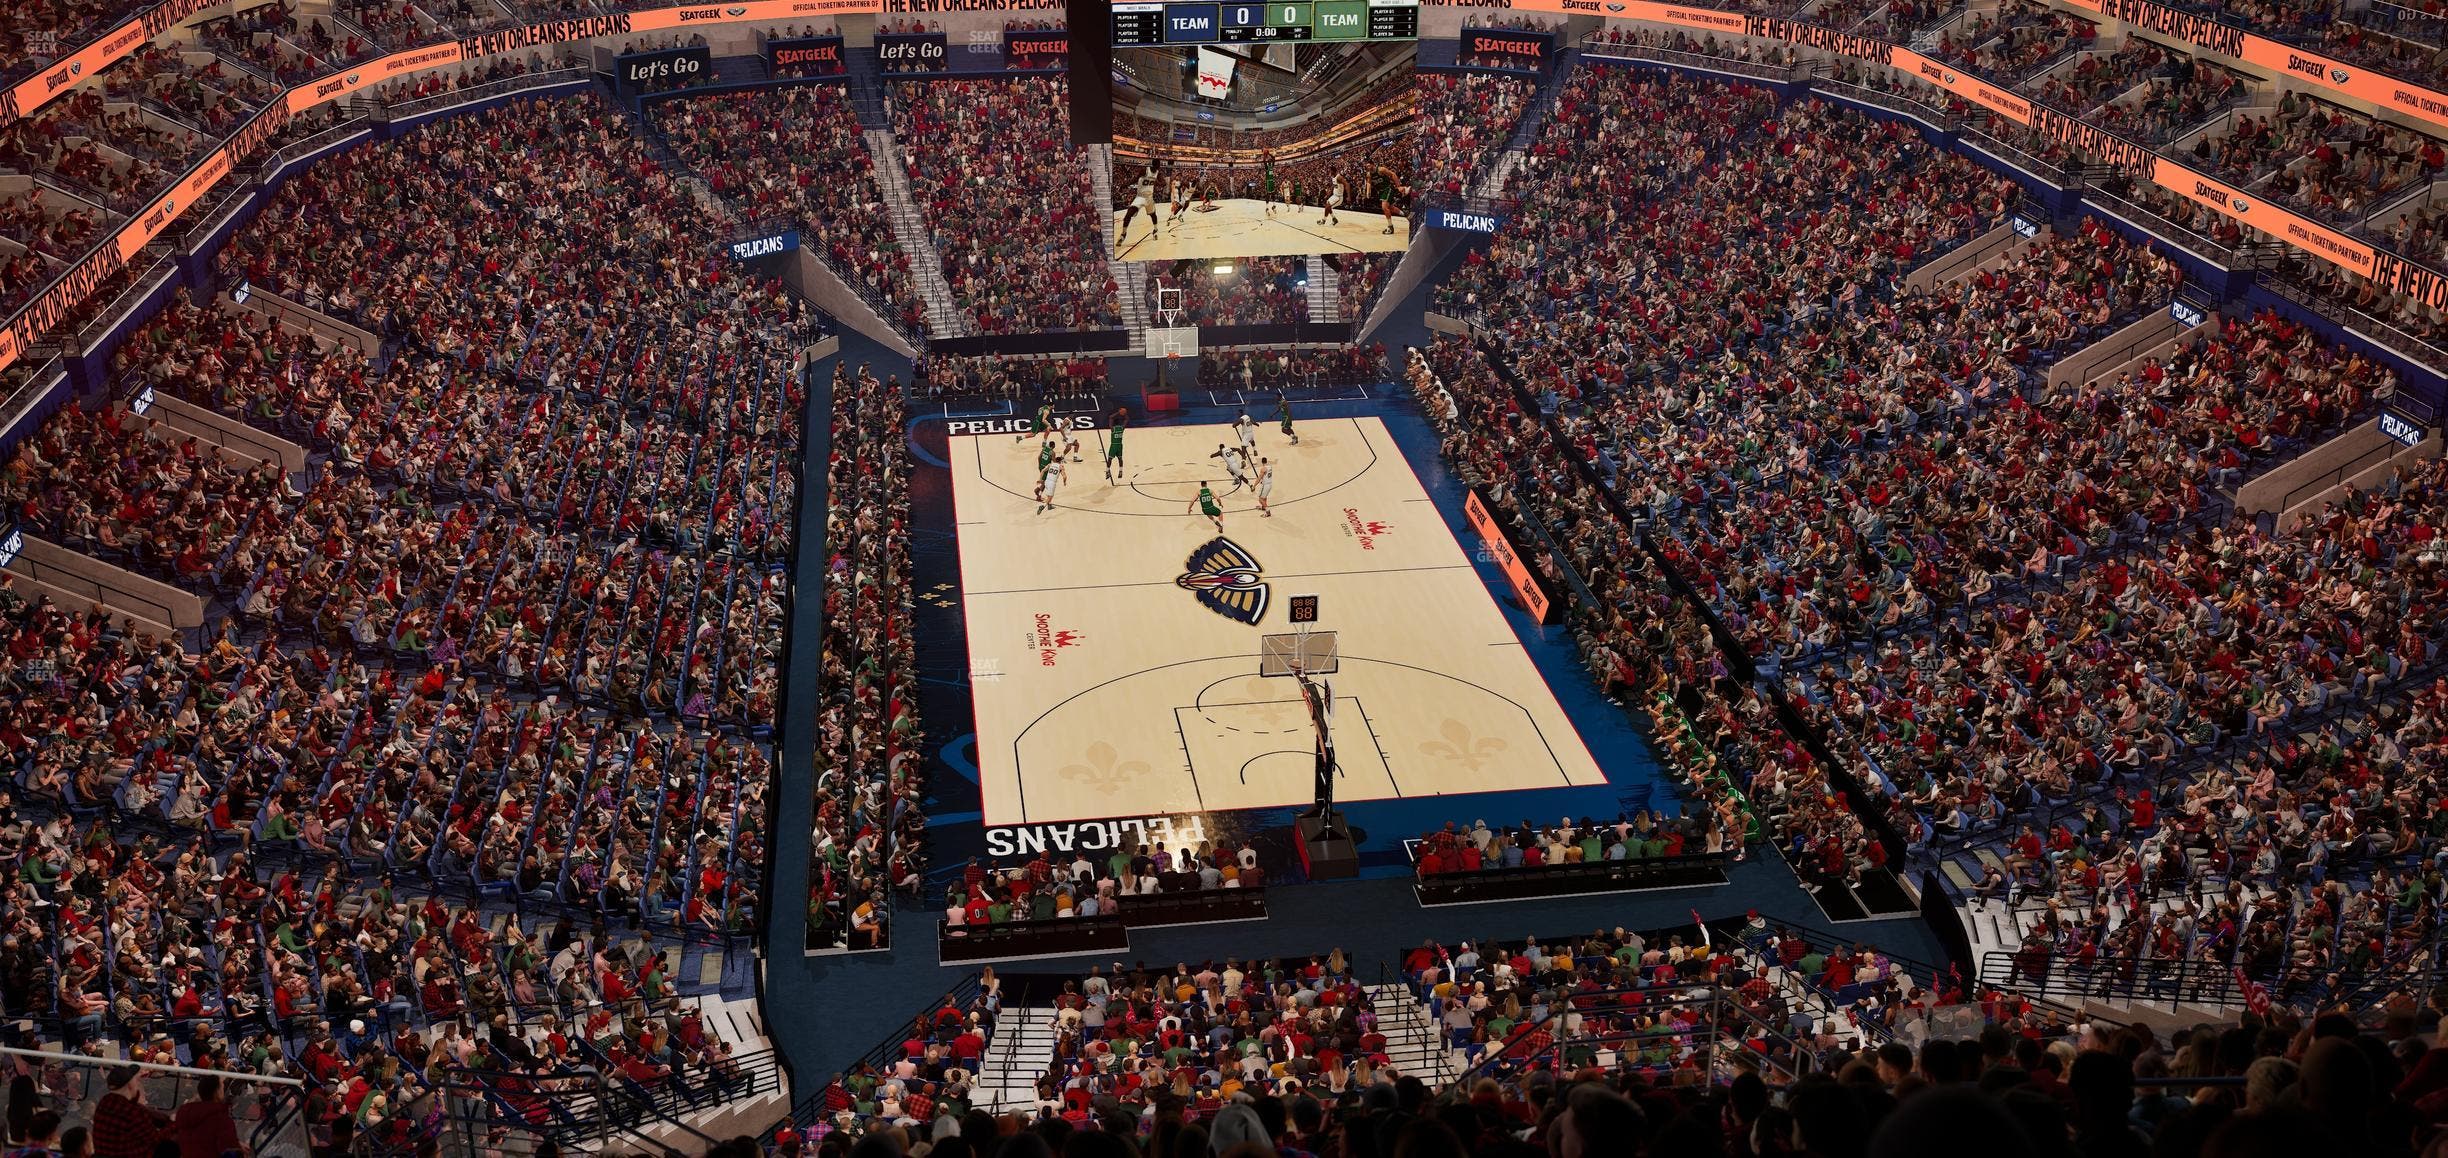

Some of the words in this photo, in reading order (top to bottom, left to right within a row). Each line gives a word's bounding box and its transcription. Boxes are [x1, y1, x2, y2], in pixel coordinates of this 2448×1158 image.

[680, 8, 721, 22] SEATGEEK
[793, 3, 816, 11] OFFICIAL
[818, 2, 844, 10] TICKETING
[1284, 7, 1296, 23] 0
[1562, 0, 1600, 11] SEATGEEK
[1172, 18, 1209, 30] TEAM
[1237, 8, 1249, 24] 0
[1322, 14, 1358, 26] TEAM
[1255, 28, 1277, 37] 0:00
[1667, 10, 1687, 19] OFFICIAL
[1688, 12, 1712, 24] TICKETING
[1713, 16, 1735, 26] PARTNER
[1735, 19, 1742, 27] OF
[1744, 15, 1766, 37] THE
[1768, 19, 1794, 42] NEW
[1795, 24, 1840, 54] ORLEANS
[1842, 34, 1893, 65] PELICANS
[2100, 0, 2118, 18] THE
[2118, 0, 2142, 24] NEW
[2142, 4, 2189, 41] ORLEANS
[2190, 17, 2244, 58] PELICANS
[386, 60, 404, 71] OFFICIAL
[405, 54, 429, 67] TICKETING
[430, 50, 450, 63] PARTNER
[450, 48, 456, 56] OF
[458, 37, 480, 60] THE
[481, 30, 506, 55] NEW
[508, 22, 566, 50] ORLEANS
[568, 13, 631, 40] PELICANS
[880, 43, 916, 59] Let's
[921, 42, 943, 58] Go
[1012, 40, 1068, 55] SEATGEEK
[1474, 37, 1541, 57] SEATGEEK
[776, 45, 838, 65] SEATGEEK
[630, 60, 668, 80] Let's
[673, 57, 699, 73] Go
[1921, 61, 1942, 81] SEATGEEK
[2287, 54, 2326, 80] SEATGEEK
[317, 78, 344, 98] SEATGEEK
[2394, 89, 2418, 107] OFFICIAL
[2029, 103, 2046, 131] THE
[2044, 109, 2066, 141] NEW
[2066, 120, 2108, 160] ORLEANS
[2108, 136, 2157, 181] PELICANS
[2194, 181, 2229, 208] SEATGEEK
[1443, 212, 1495, 232] PELICANS
[733, 236, 783, 259] PELICANS
[2287, 223, 2310, 241] OFFICIAL
[2310, 233, 2337, 253] TICKETING
[2337, 243, 2361, 263] PARTNER
[2361, 254, 2370, 266] OF
[2371, 250, 2399, 288] THE
[2398, 262, 2434, 305] NEW
[9, 310, 34, 355] THE
[28, 295, 51, 341] NEW
[48, 270, 87, 324] ORLEANS
[84, 238, 122, 295] PELICANS
[947, 416, 1095, 435] PELICNS
[2381, 413, 2419, 446] PELICANS
[1048, 467, 1058, 476] 00
[1201, 495, 1211, 503] 00
[1470, 499, 1487, 528] SEATGEEK
[1523, 578, 1542, 612] SEATGEEK
[1296, 607, 1312, 619] 88
[1034, 613, 1052, 647] SMOOTHIE
[1026, 633, 1035, 650] CENTER
[985, 816, 1209, 856] PELICANS
[975, 908, 984, 918] 00
